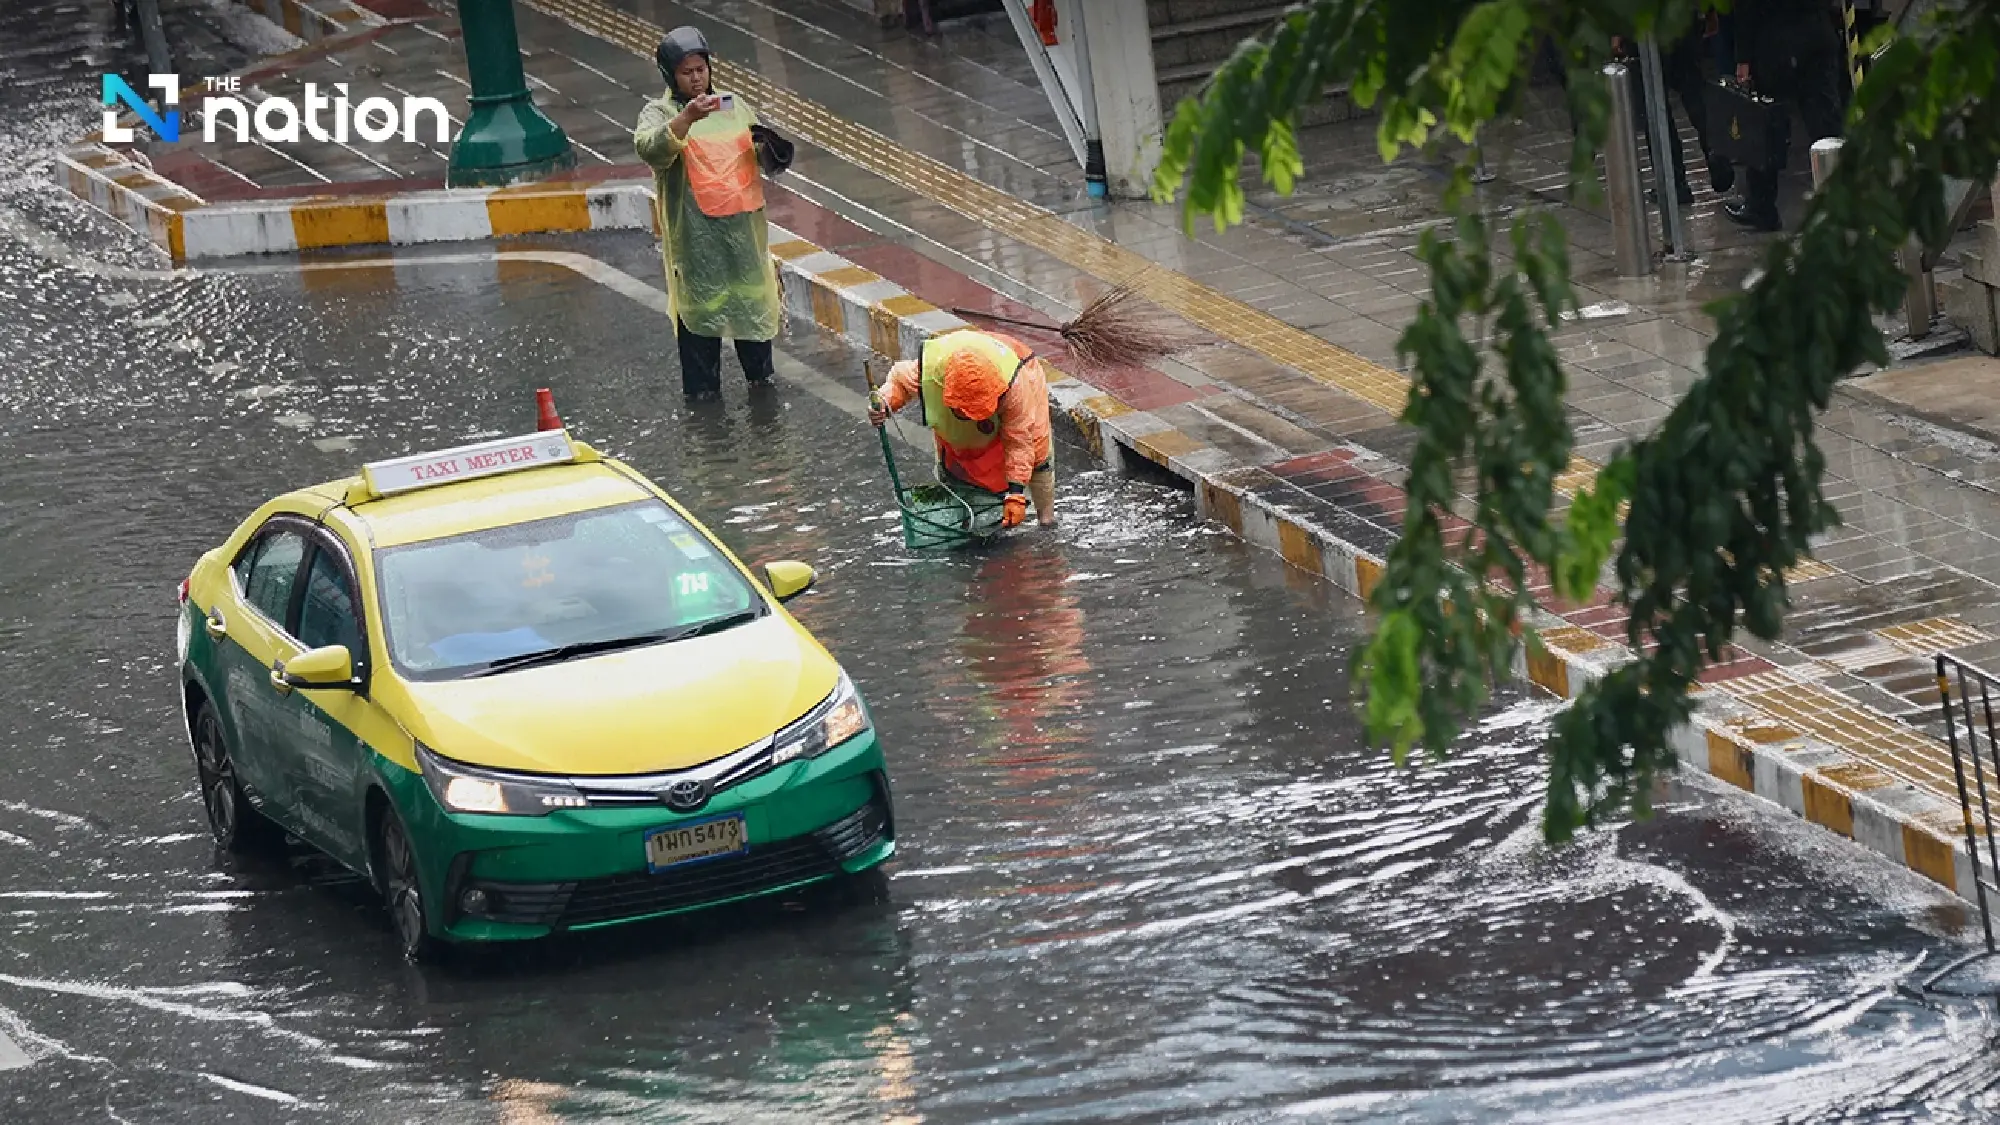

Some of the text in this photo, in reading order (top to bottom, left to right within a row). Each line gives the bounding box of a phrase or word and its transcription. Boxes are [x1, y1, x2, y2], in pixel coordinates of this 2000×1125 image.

[410, 445, 538, 480] TAXI METER
[694, 819, 738, 844] 5473
